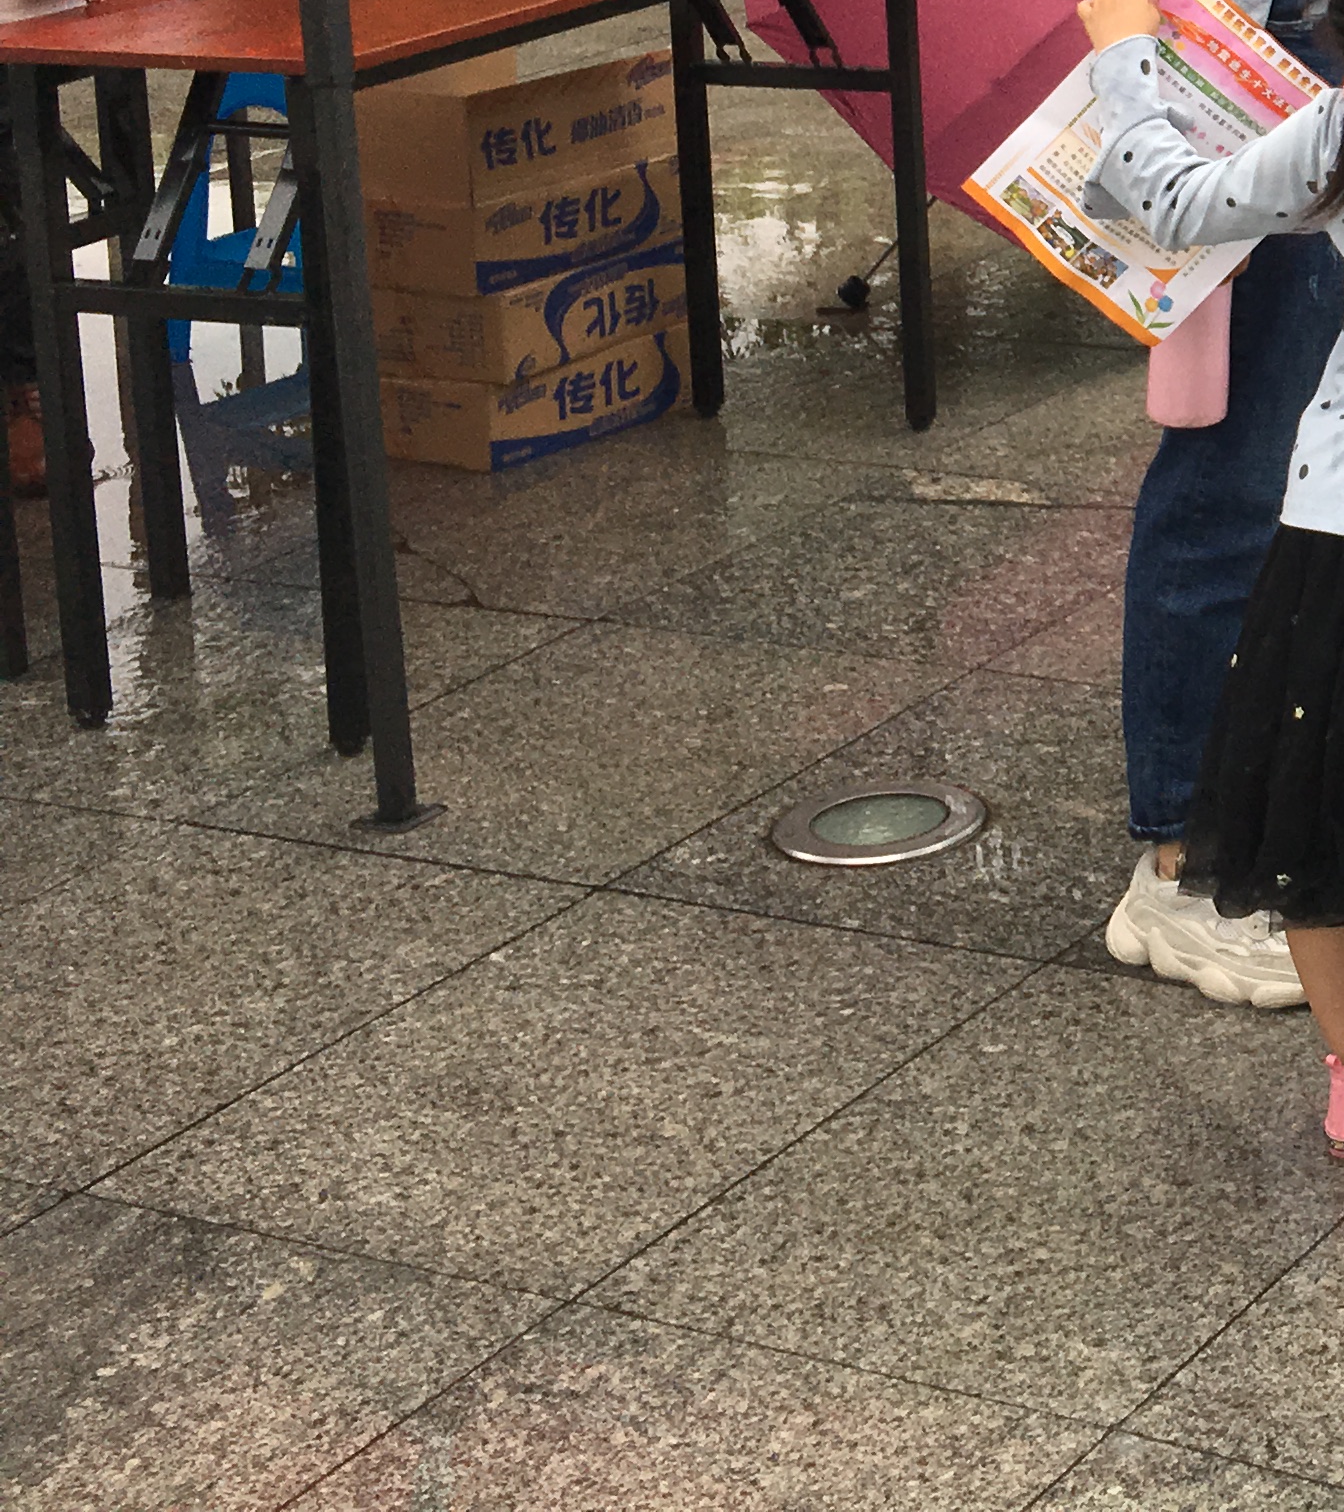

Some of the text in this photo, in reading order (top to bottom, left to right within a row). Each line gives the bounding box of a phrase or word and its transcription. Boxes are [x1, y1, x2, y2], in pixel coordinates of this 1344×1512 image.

[480, 117, 557, 170] 传化
[538, 186, 622, 246] 传化
[583, 278, 661, 338] 传化
[553, 359, 641, 421] 传化
